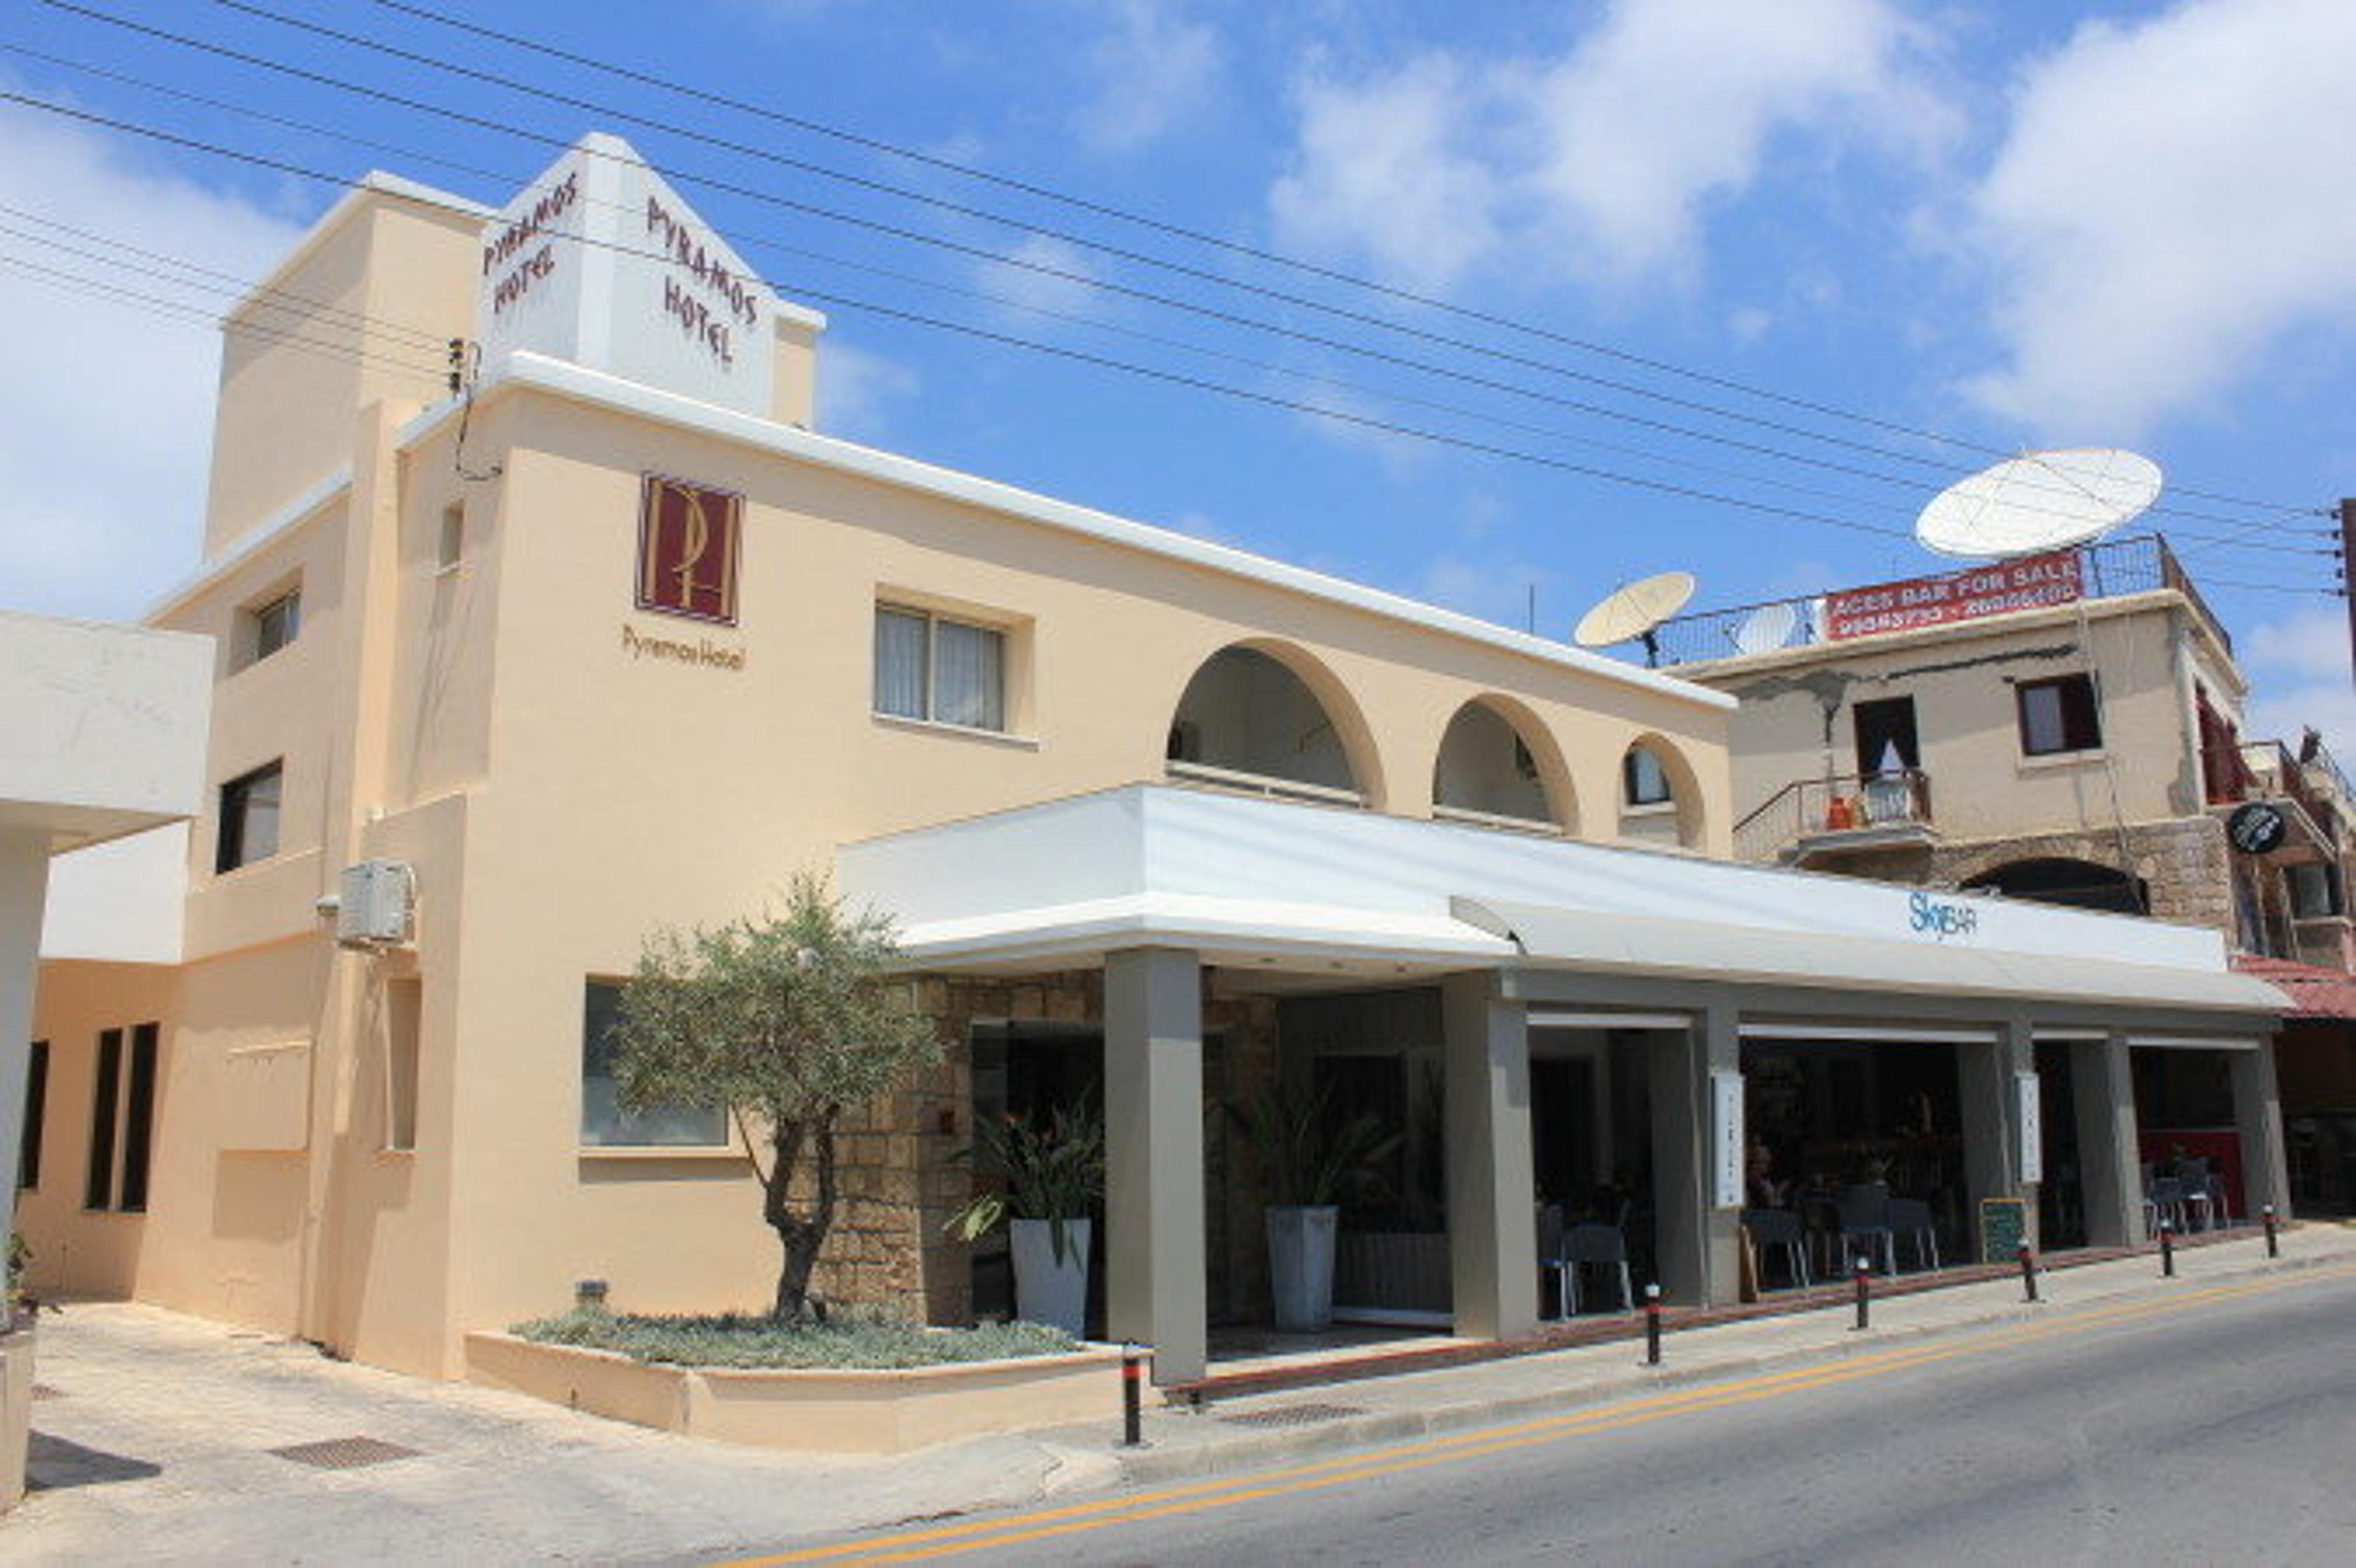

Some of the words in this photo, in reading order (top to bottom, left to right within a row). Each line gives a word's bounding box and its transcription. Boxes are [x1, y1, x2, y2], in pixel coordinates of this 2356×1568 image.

[483, 172, 577, 275] PYRAMOS
[647, 195, 758, 325] PYRAMOS
[495, 244, 555, 314] HOTEL
[665, 275, 733, 363] HOTEL
[1903, 583, 1951, 606] BAR
[1957, 571, 2005, 597] FOR
[2013, 559, 2078, 586] SALE
[700, 639, 746, 671] Hotel
